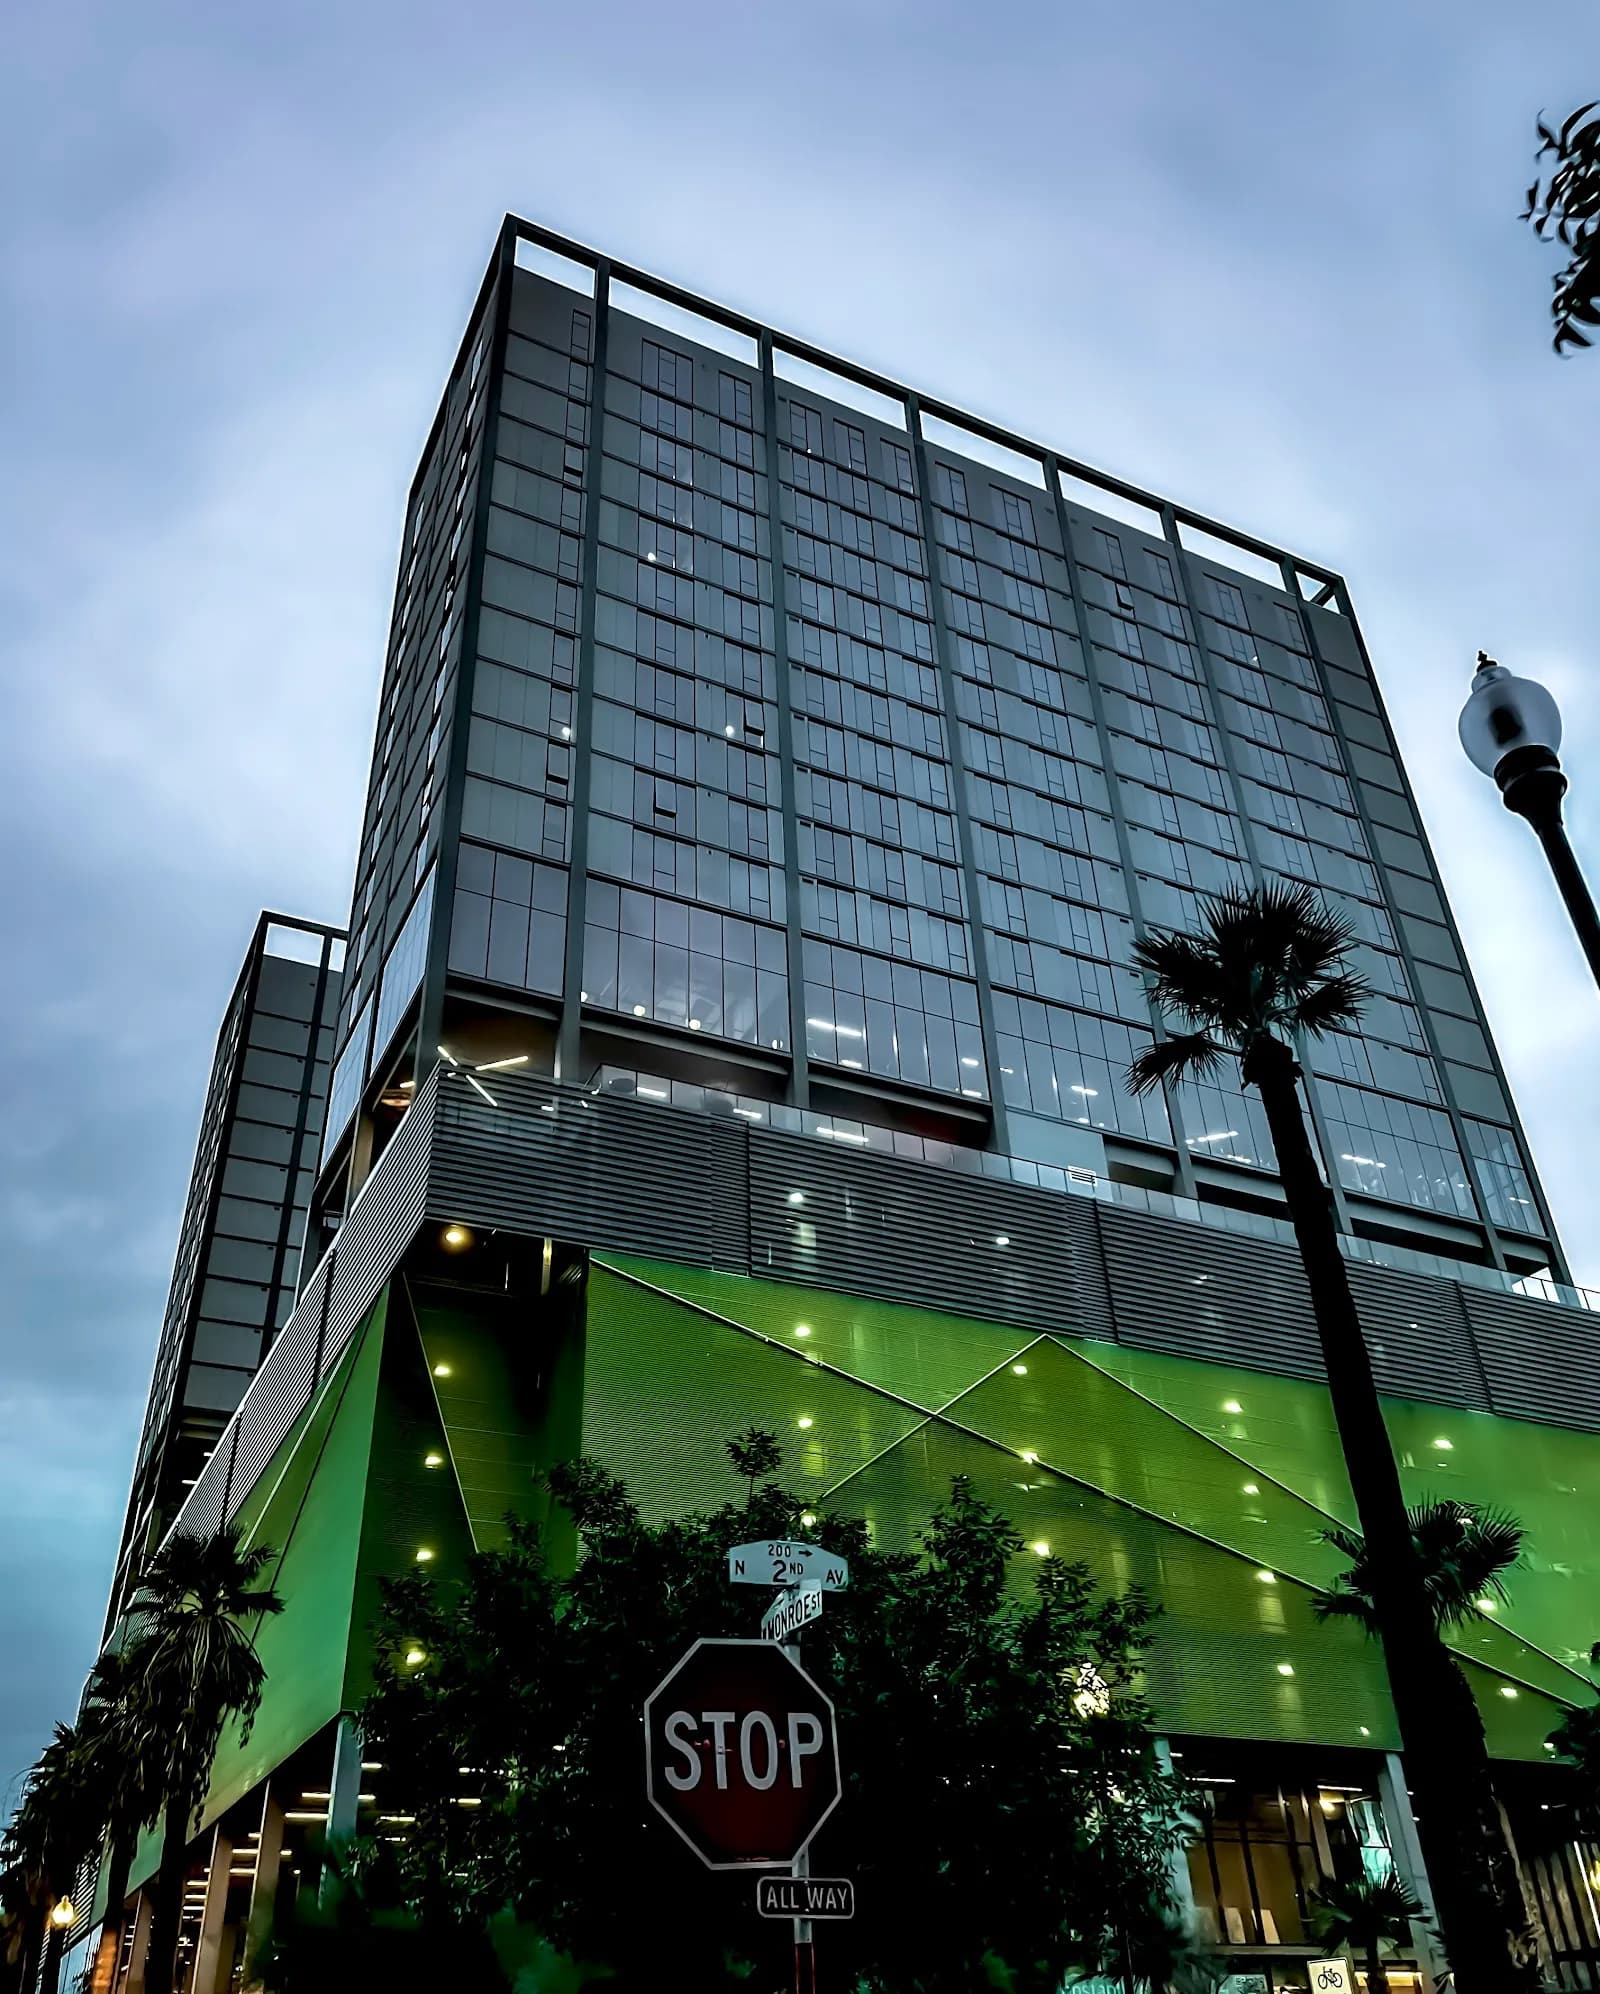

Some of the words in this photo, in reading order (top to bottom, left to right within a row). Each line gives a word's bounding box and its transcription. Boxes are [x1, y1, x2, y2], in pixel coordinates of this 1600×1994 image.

[768, 1544, 791, 1557] 200
[735, 1560, 745, 1575] N
[772, 1560, 804, 1582] 2ND
[826, 1569, 844, 1584] AV
[767, 1594, 811, 1640] MONROE
[812, 1591, 821, 1610] ST
[665, 1710, 823, 1790] STOP
[767, 1886, 799, 1908] ALL
[807, 1887, 847, 1909] WAY
